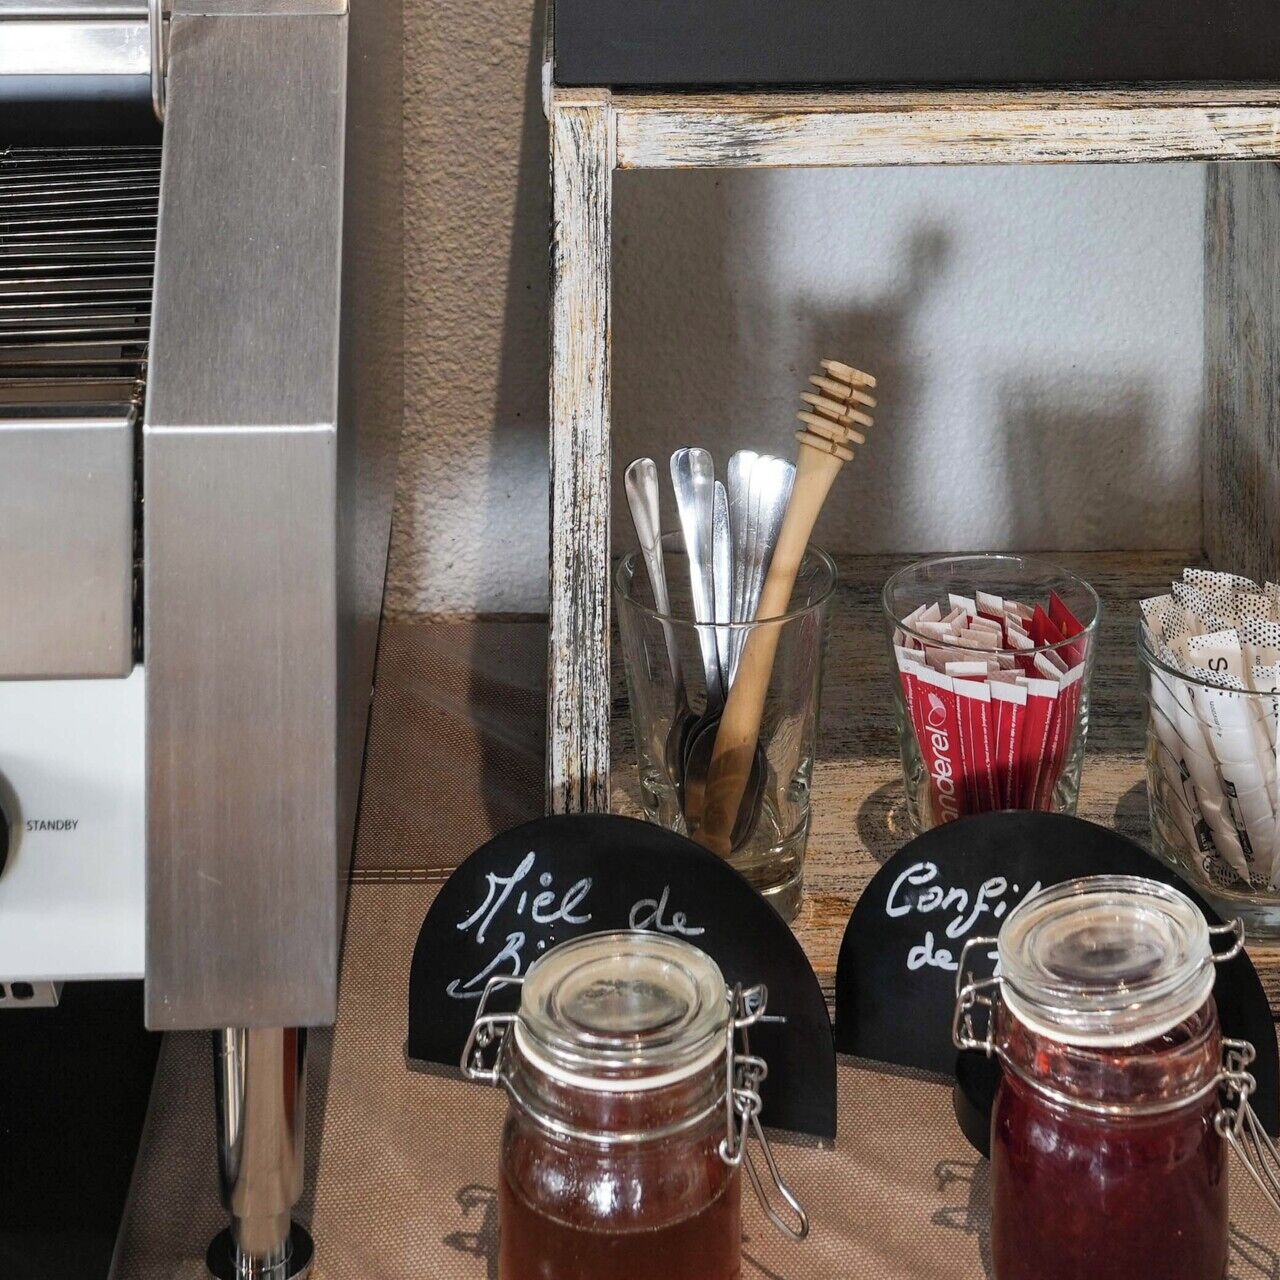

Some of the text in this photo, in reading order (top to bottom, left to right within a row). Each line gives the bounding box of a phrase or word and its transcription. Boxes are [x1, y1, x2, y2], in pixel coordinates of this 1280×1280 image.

[25, 819, 80, 832] STANDBY
[457, 851, 706, 944] Miel de
[907, 931, 959, 972] de
